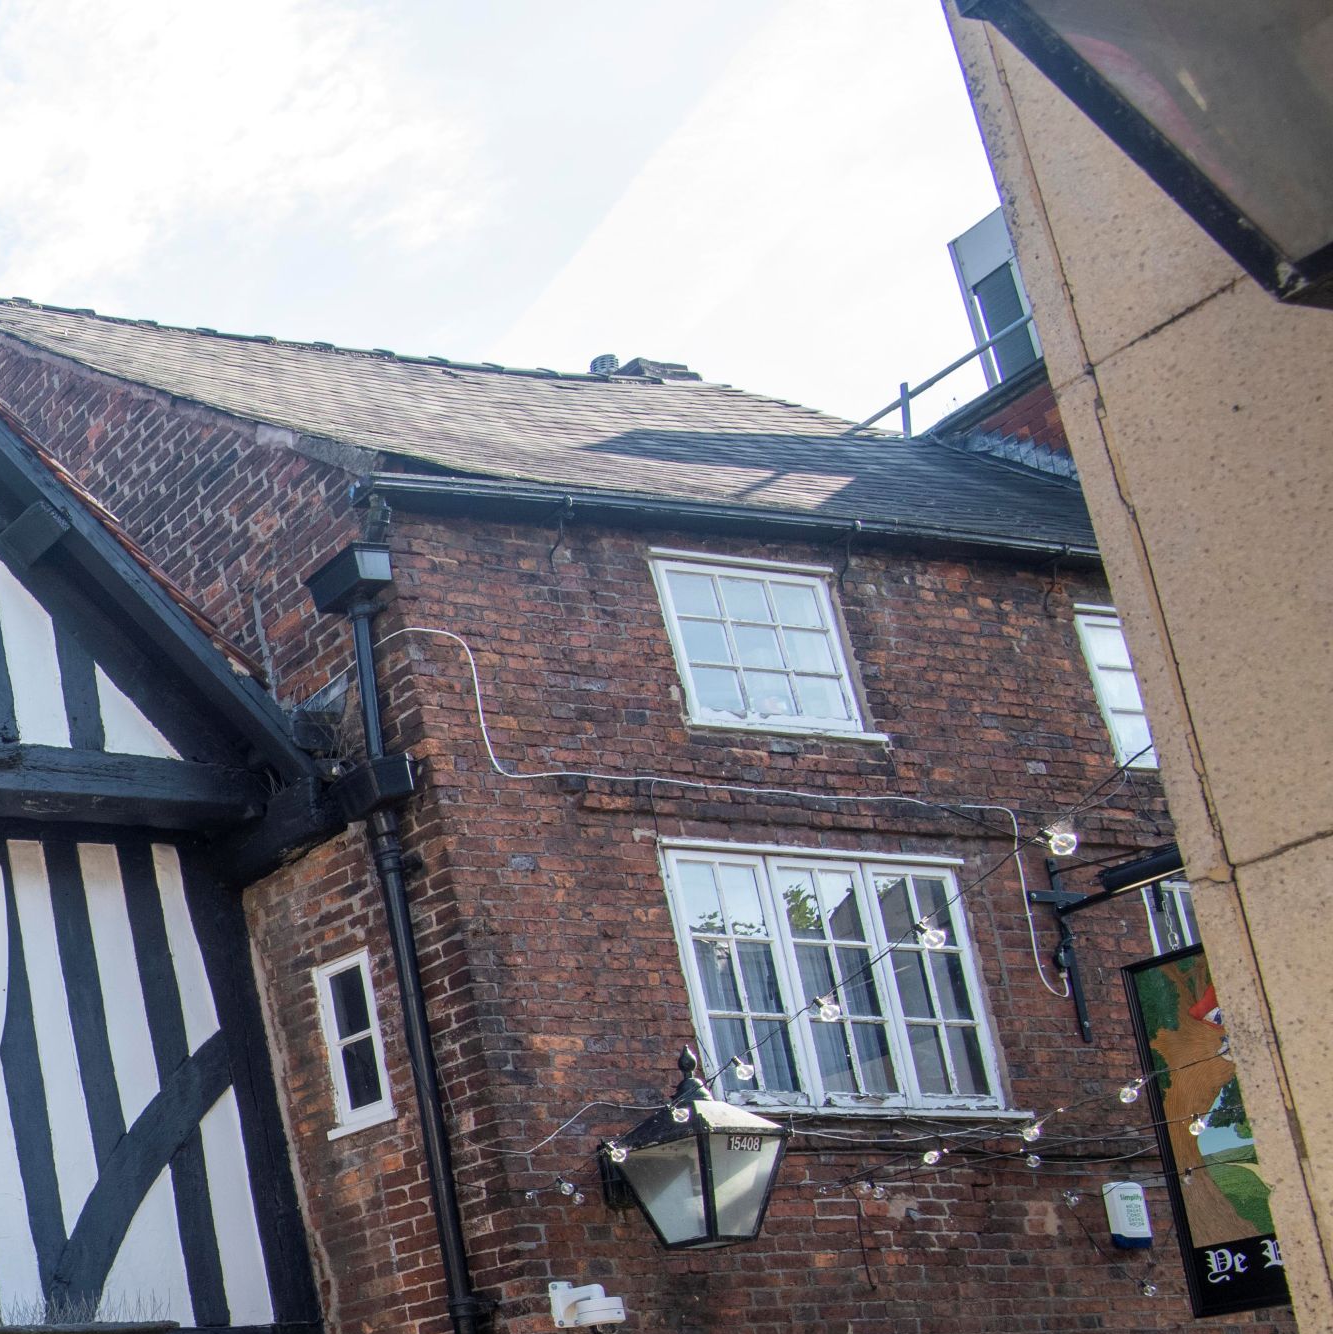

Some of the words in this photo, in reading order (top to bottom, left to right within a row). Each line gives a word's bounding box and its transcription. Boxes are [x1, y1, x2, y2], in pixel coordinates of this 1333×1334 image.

[730, 1136, 760, 1150] 15408
[1120, 1193, 1142, 1201] Simplify
[1204, 1248, 1248, 1284] Ye
